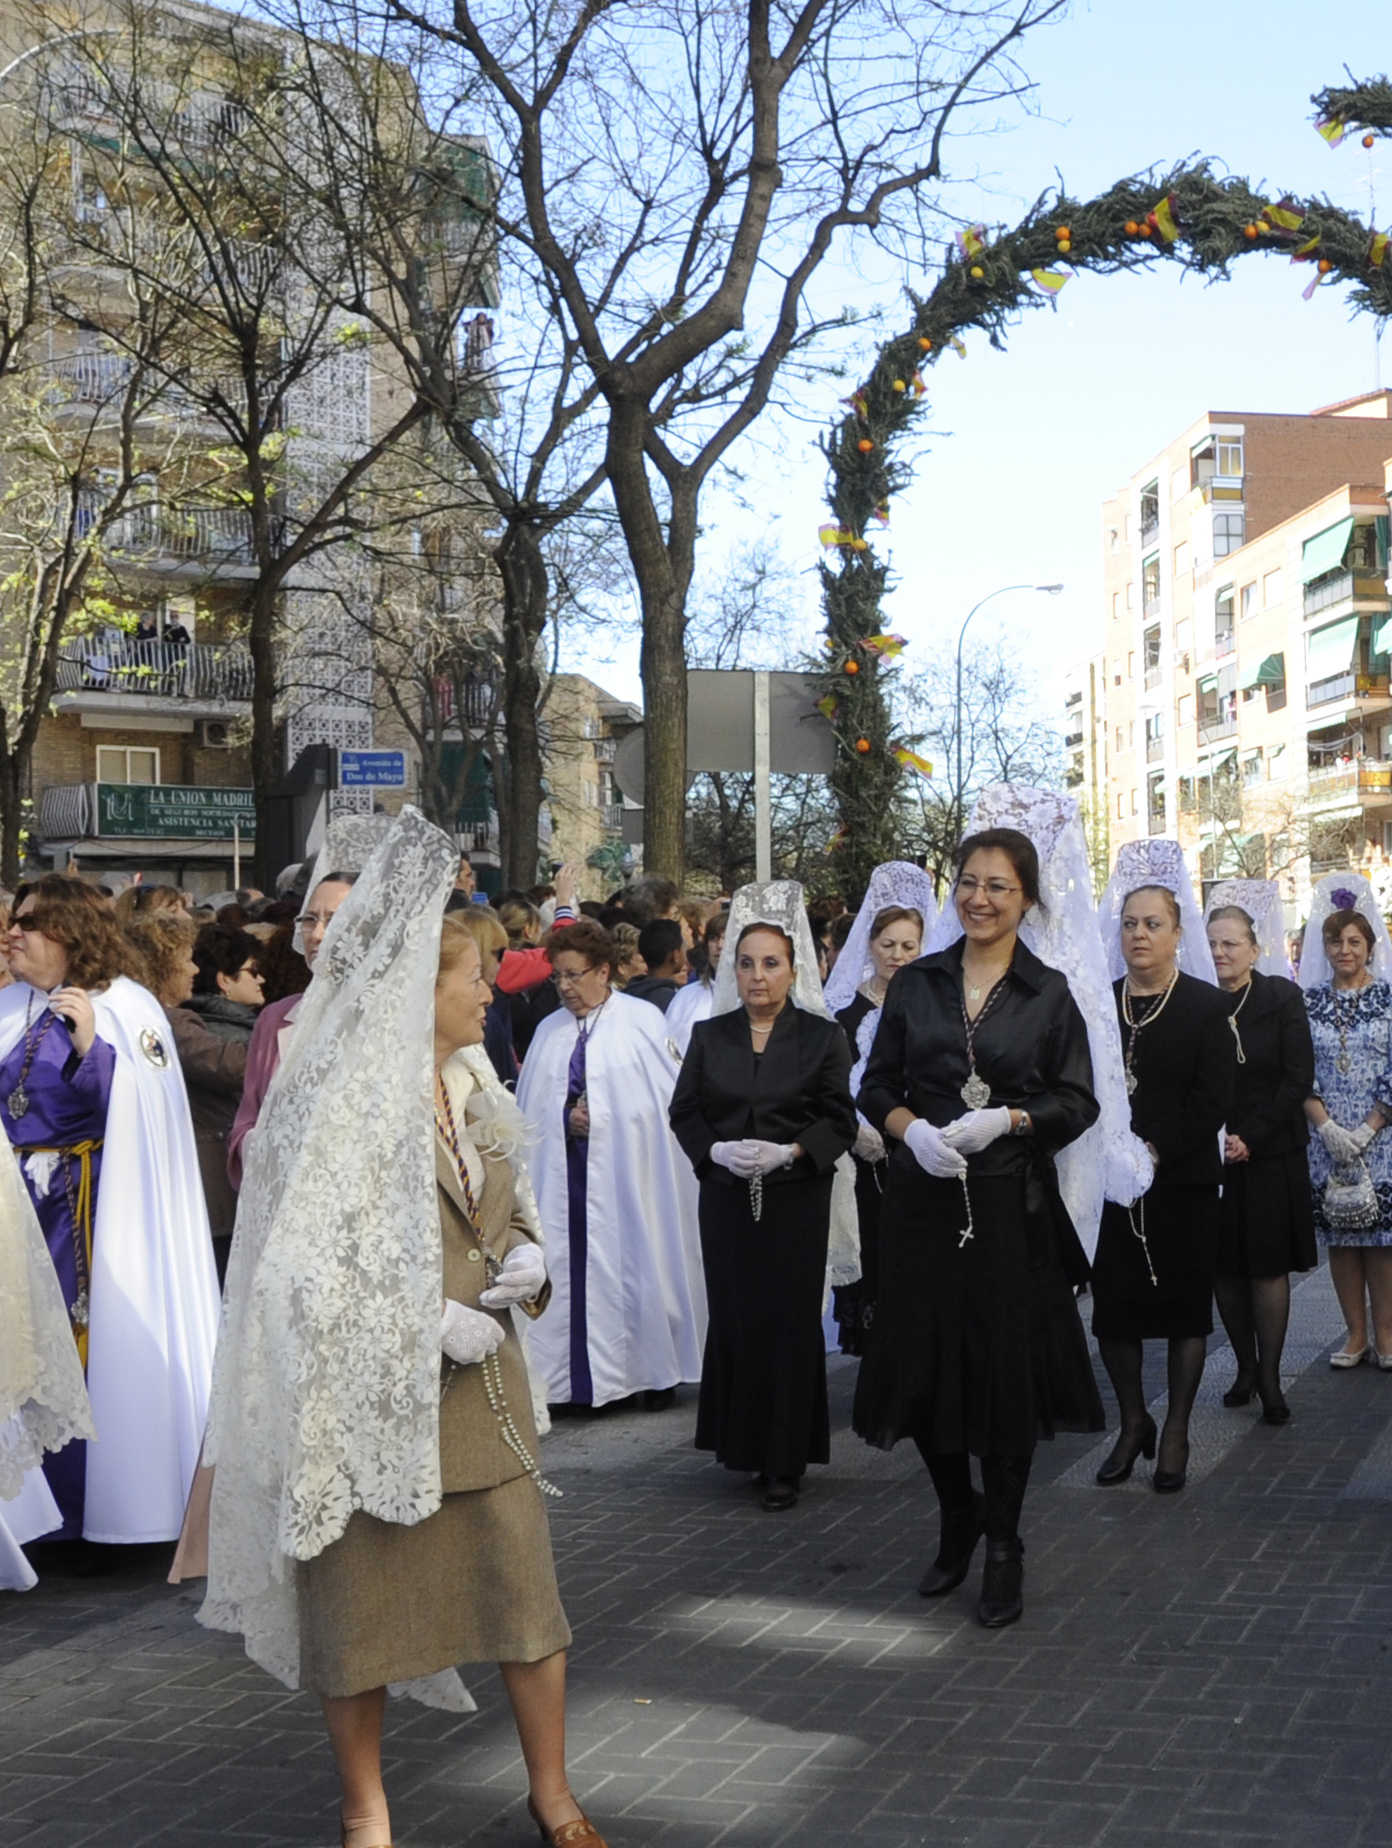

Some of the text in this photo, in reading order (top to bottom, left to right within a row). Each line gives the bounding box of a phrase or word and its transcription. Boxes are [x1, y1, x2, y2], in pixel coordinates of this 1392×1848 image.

[347, 772, 403, 782] Dos de Mayo
[149, 789, 254, 807] LA UNION MADRIL
[157, 817, 257, 828] ASISTENCIA SANTAR
